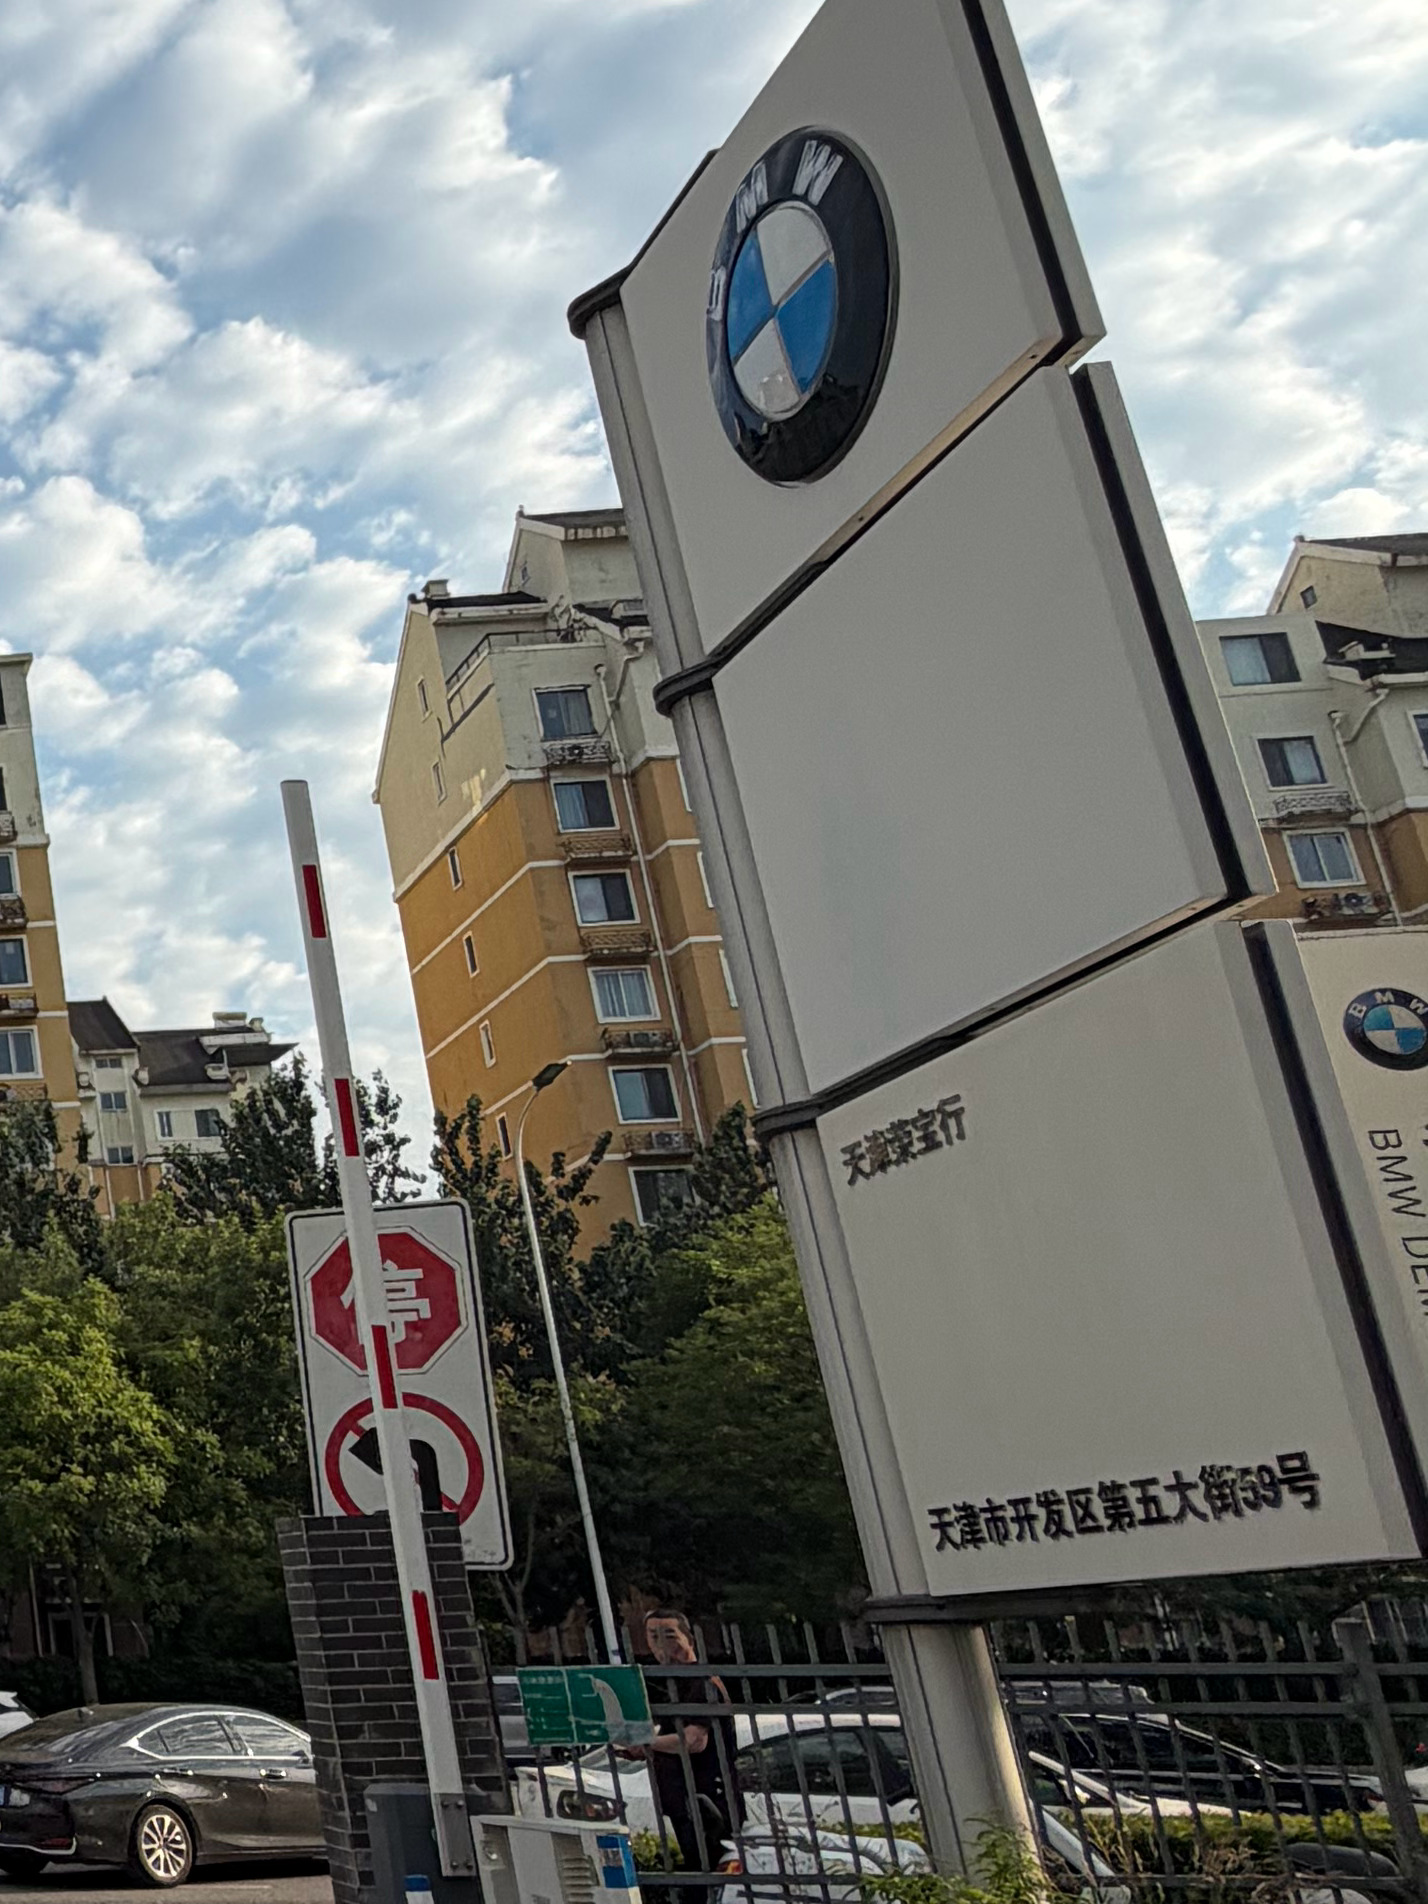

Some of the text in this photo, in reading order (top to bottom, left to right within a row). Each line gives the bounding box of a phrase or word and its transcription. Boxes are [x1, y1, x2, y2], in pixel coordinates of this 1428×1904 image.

[706, 139, 844, 321] BMW
[1348, 991, 1428, 1020] BMW
[1367, 1129, 1427, 1218] BMW
[927, 1450, 1322, 1553] 天津市开发区第五大街59号
